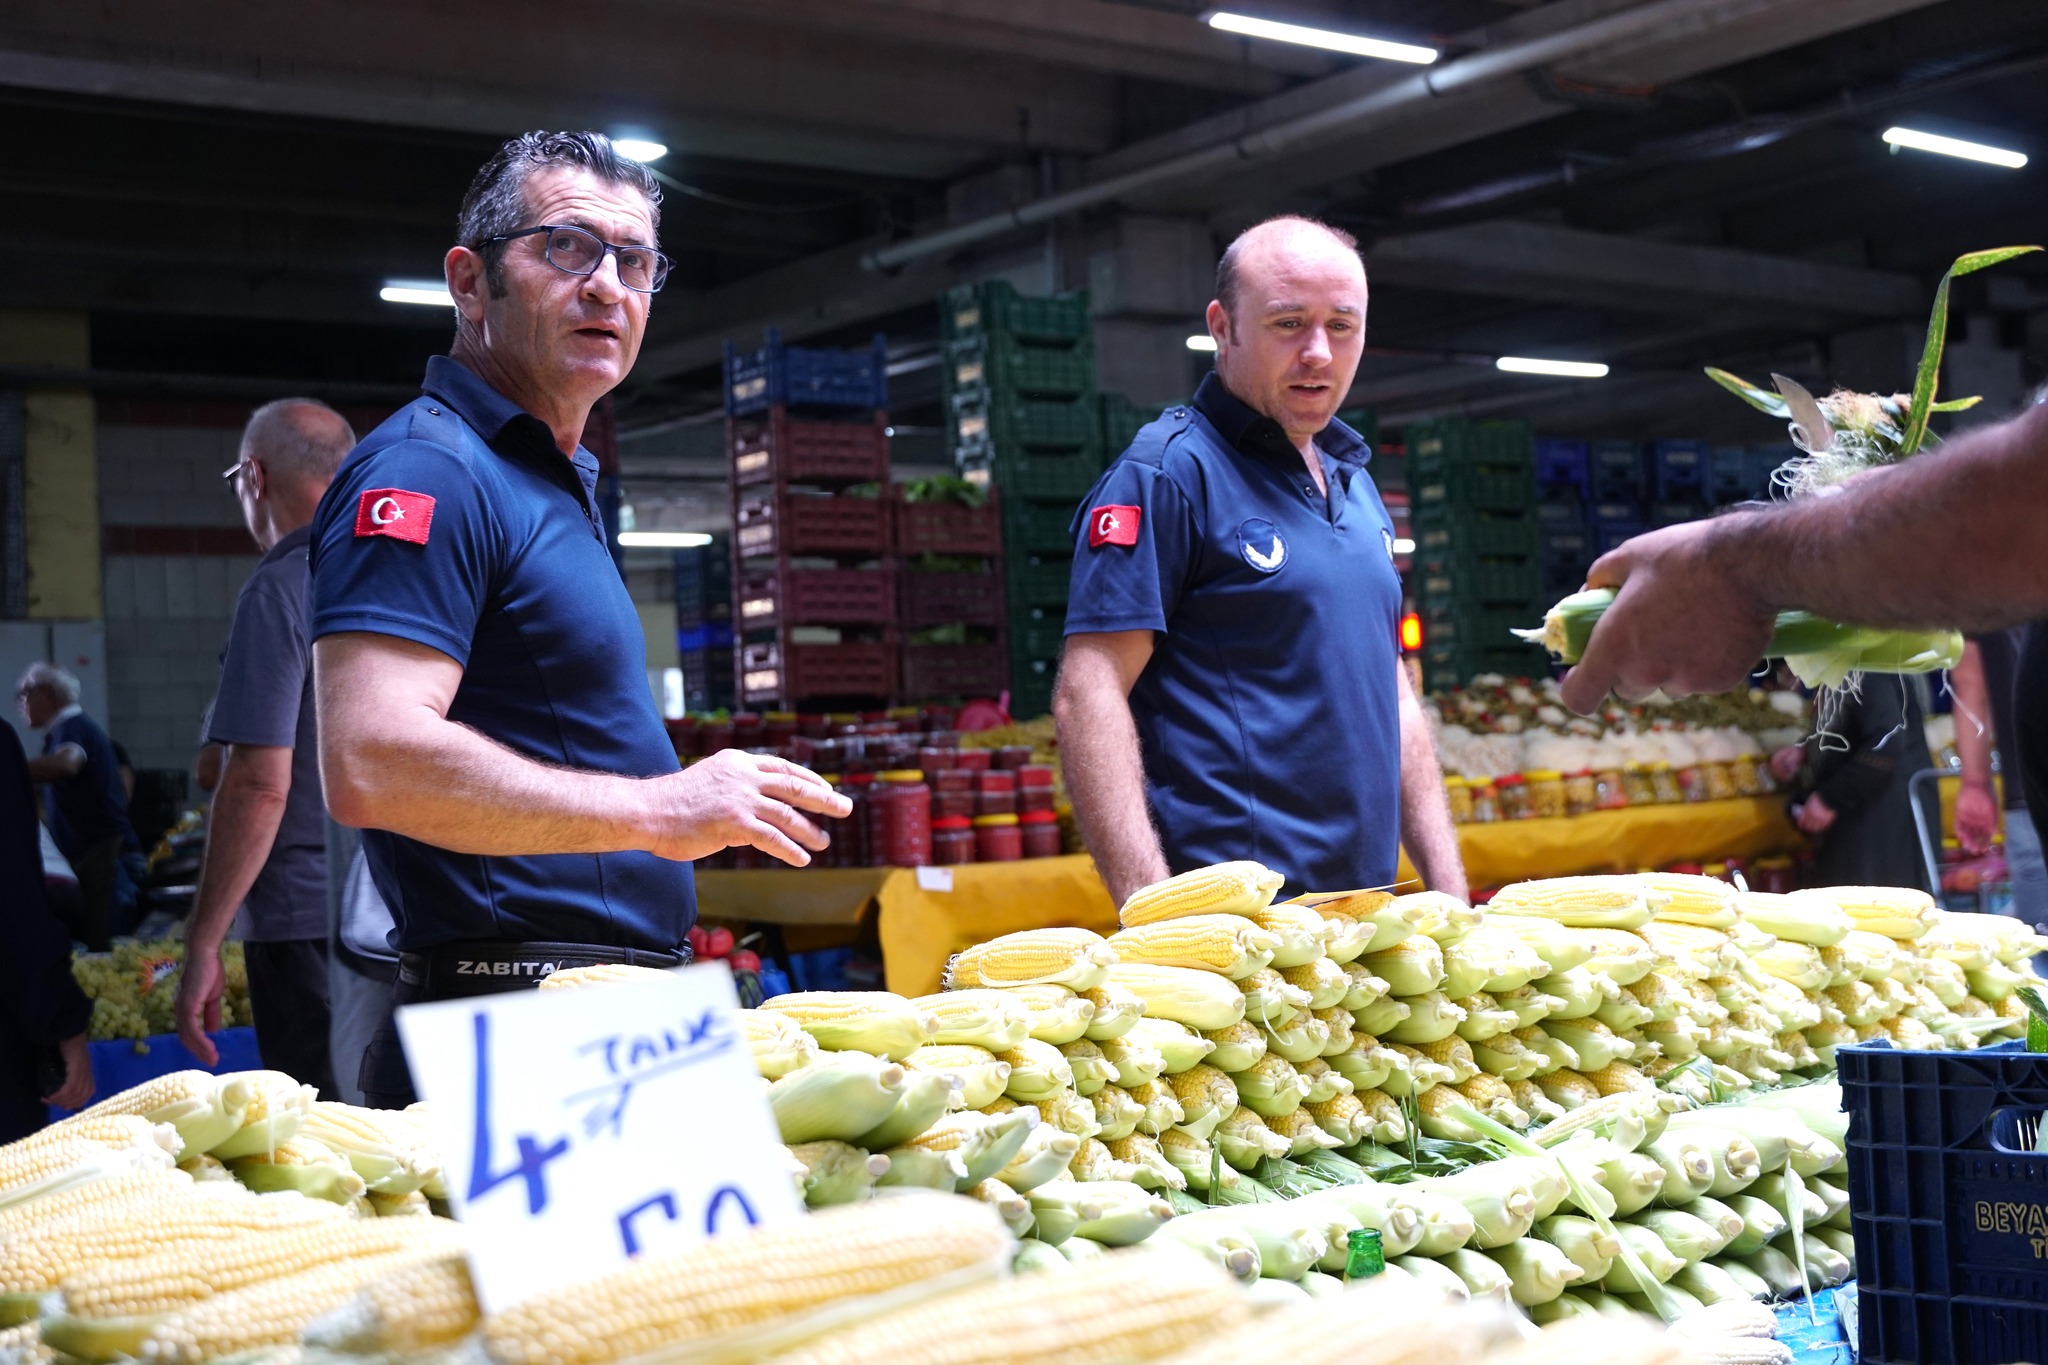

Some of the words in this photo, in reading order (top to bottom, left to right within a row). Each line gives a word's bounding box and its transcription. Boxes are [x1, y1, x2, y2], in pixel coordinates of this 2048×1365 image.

[457, 961, 557, 975] ZABITA
[466, 1011, 570, 1216] 4
[1975, 1201, 2048, 1236] BEYA
